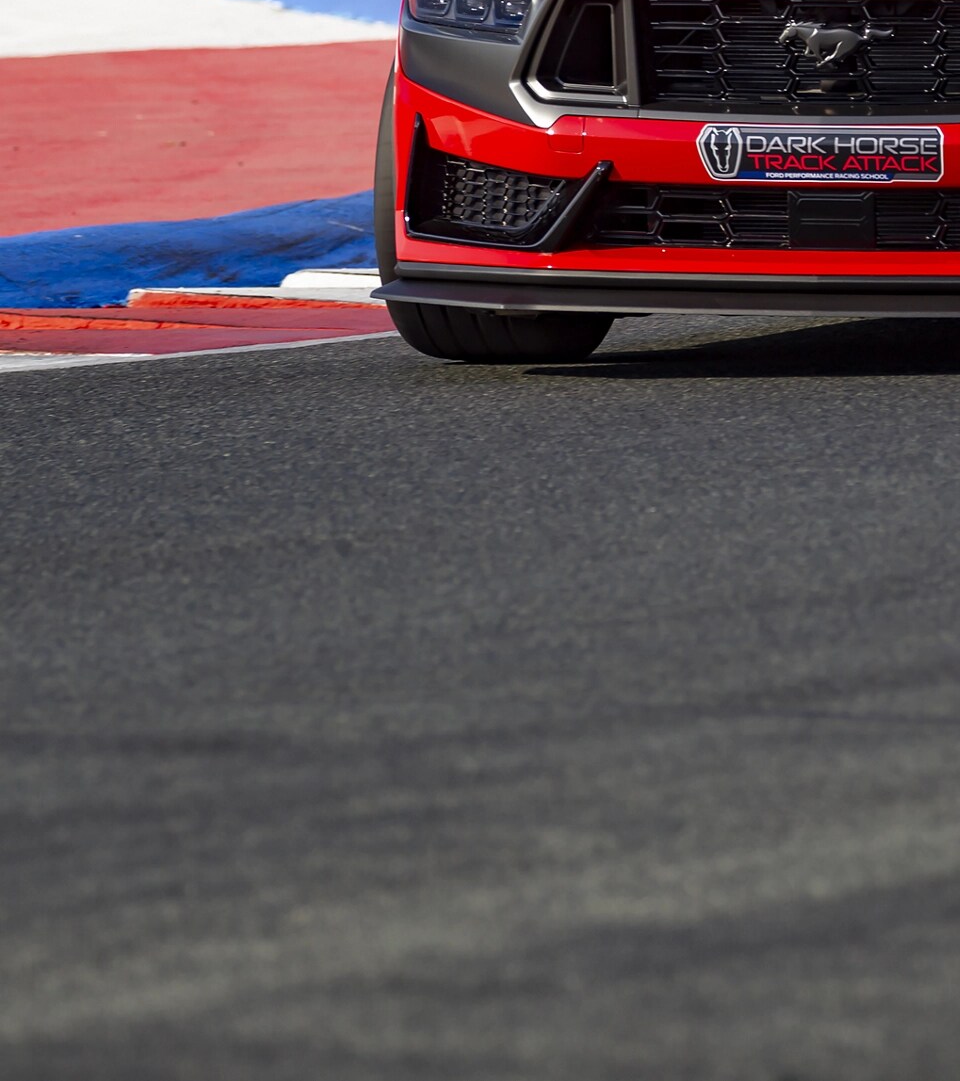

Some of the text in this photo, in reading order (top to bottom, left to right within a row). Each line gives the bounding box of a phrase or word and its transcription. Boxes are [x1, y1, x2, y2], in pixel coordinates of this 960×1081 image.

[746, 135, 938, 155] DARK HORSE
[746, 154, 939, 172] TRACK ATTACK
[834, 172, 860, 180] RACING
[861, 172, 889, 180] SCHOOL
